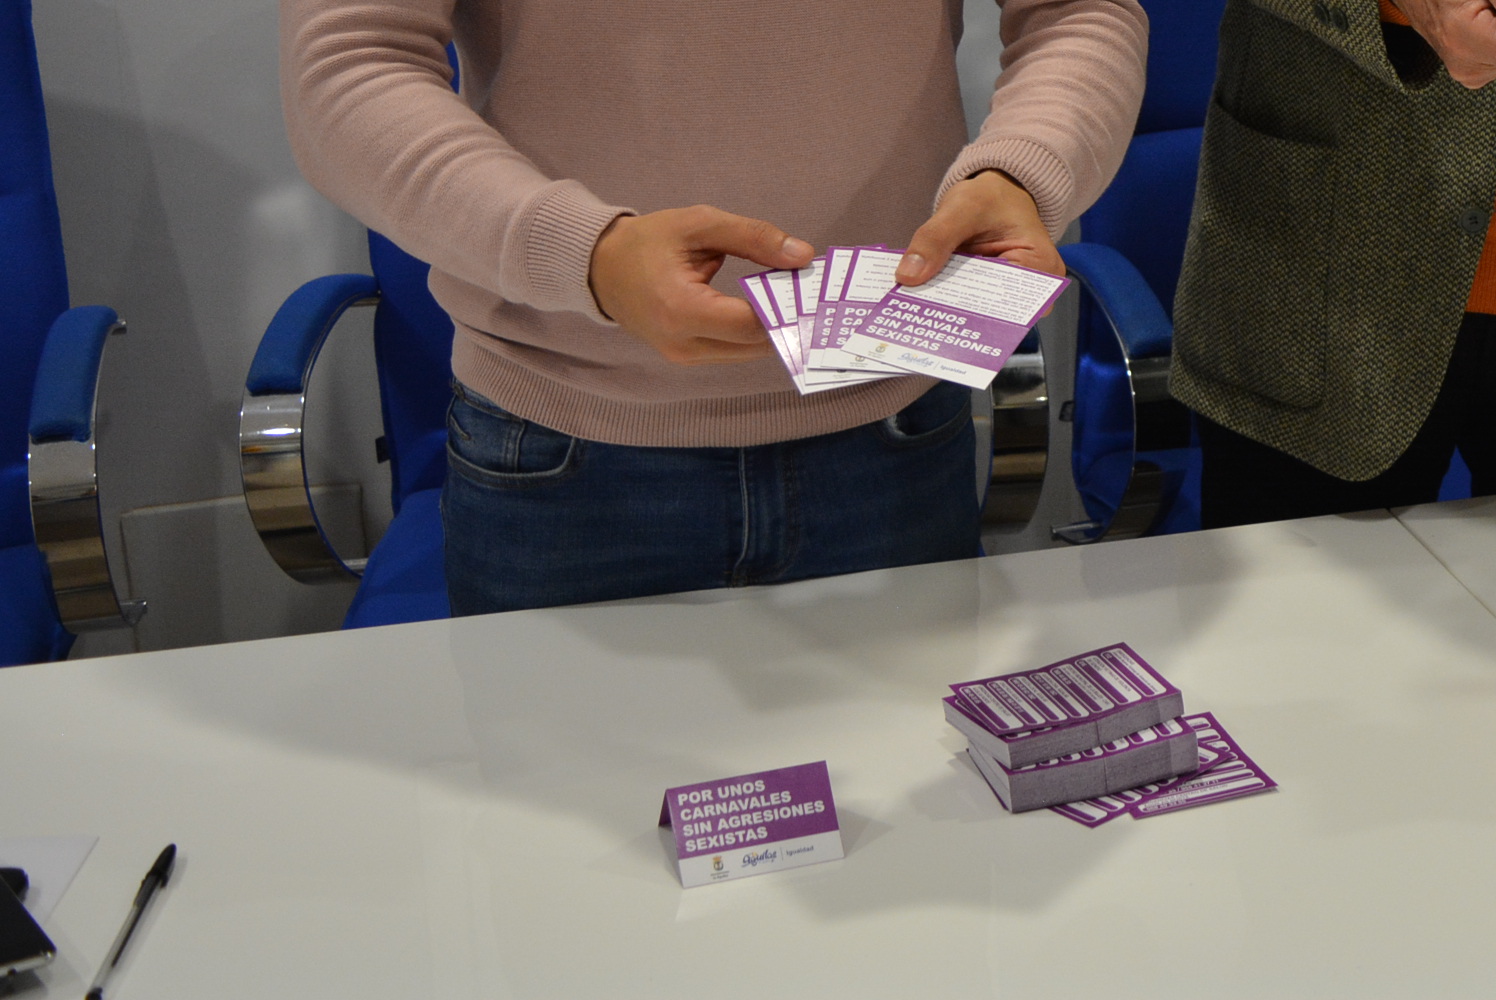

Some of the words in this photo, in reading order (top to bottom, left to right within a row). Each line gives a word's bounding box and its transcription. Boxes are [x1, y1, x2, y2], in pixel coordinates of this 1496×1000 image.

[881, 308, 981, 340] CARNAVALES
[888, 299, 921, 313] POR
[923, 308, 967, 325] UNOS
[866, 325, 941, 351] SEXISTAS
[874, 316, 899, 329] SIN
[902, 324, 1002, 357] AGRESIONES
[677, 789, 713, 806] POR
[717, 780, 765, 799] UNOS
[680, 791, 792, 821] CARNAVALES
[683, 821, 712, 836] SIN
[717, 800, 825, 831] AGRESIONES
[685, 826, 768, 852] SEXISTAS
